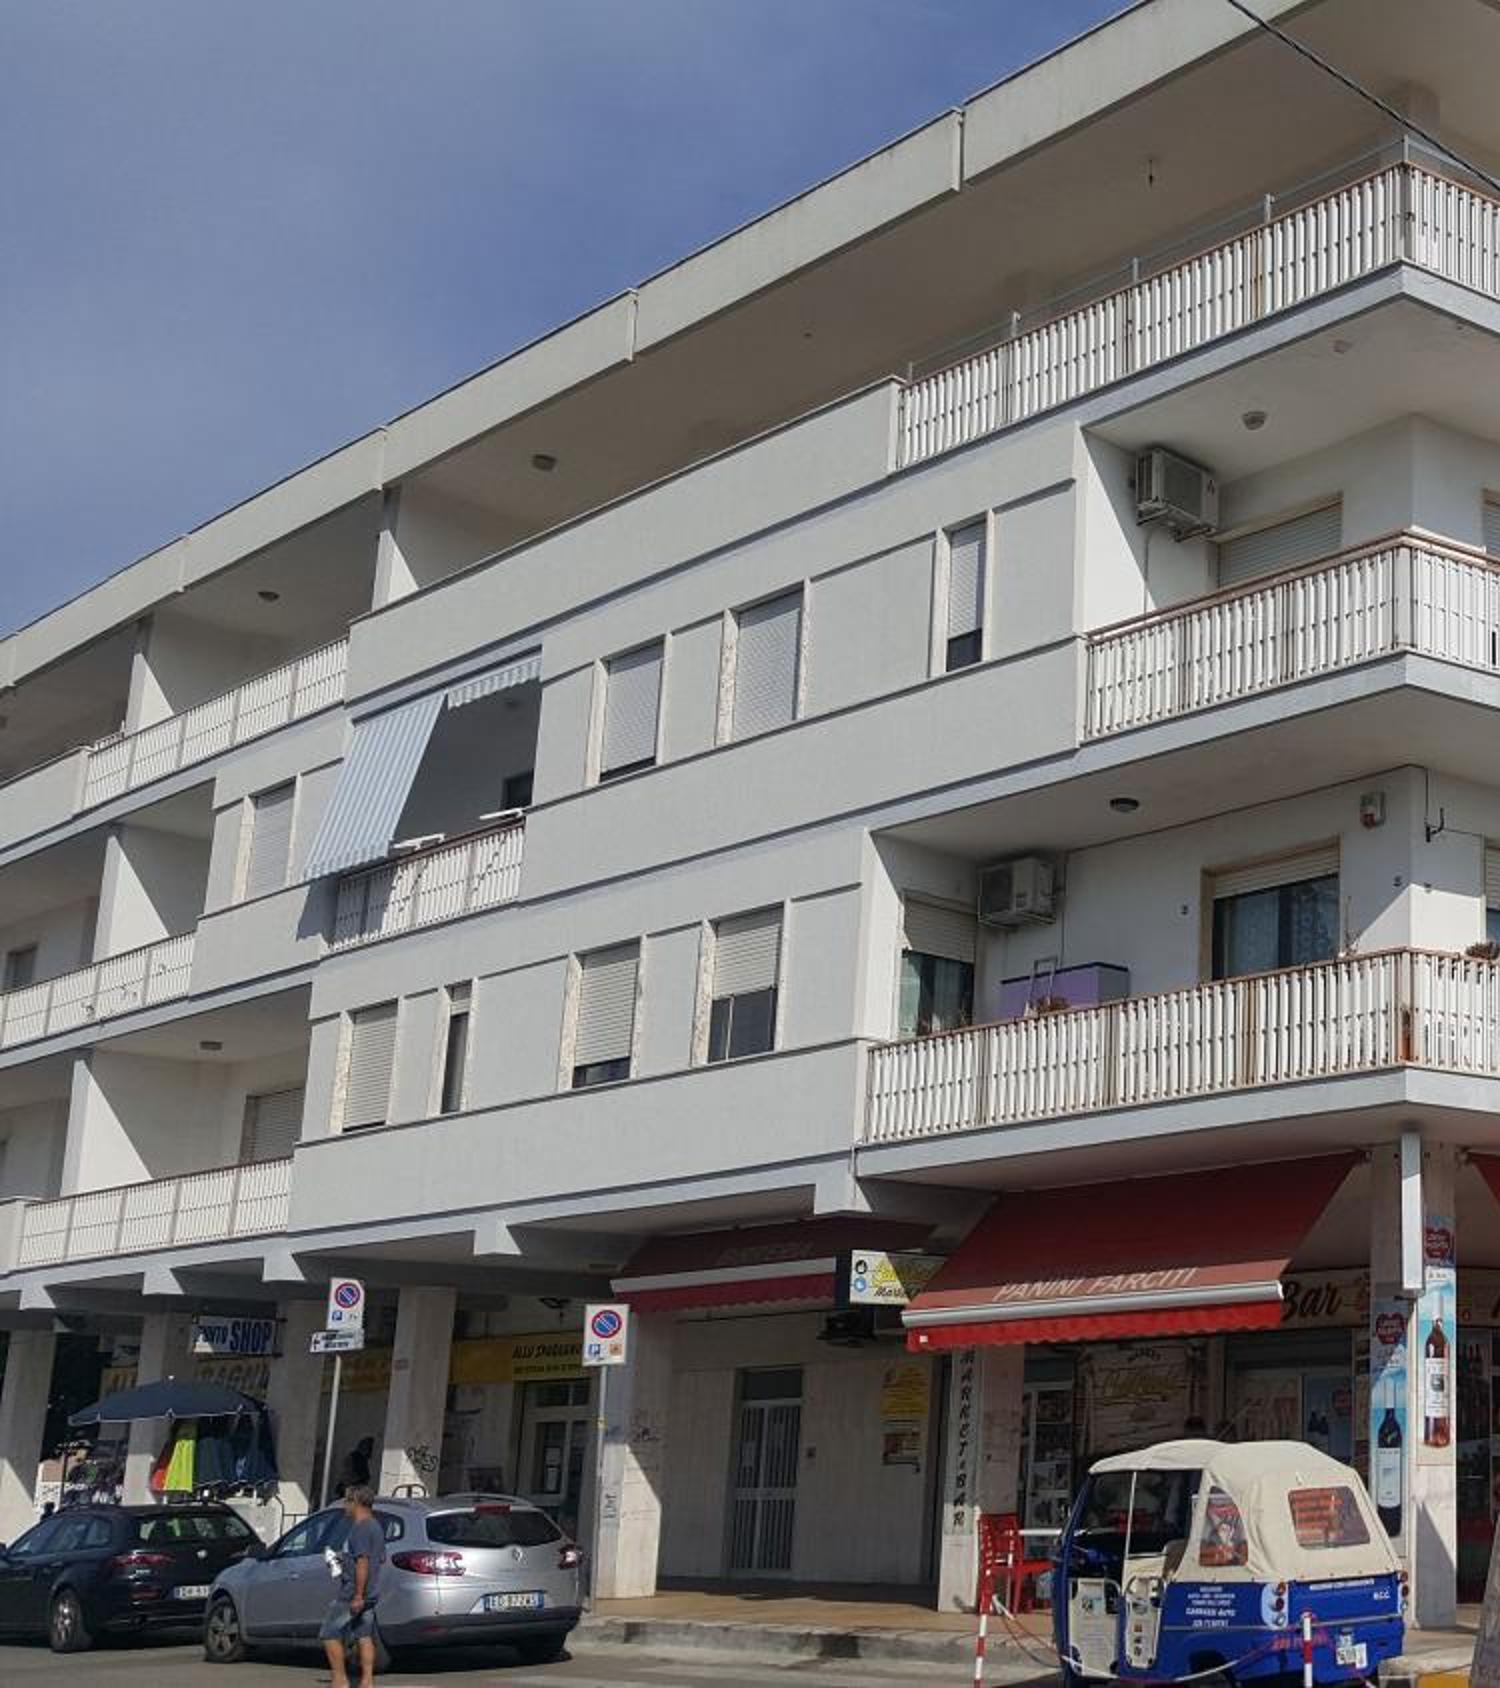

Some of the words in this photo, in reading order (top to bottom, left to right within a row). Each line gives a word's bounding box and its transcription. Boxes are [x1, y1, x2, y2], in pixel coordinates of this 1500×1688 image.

[993, 1279, 1083, 1300] PANINI
[1087, 1267, 1198, 1294] FARCITI
[1282, 1281, 1341, 1321] Bar
[230, 1320, 273, 1353] SHOP
